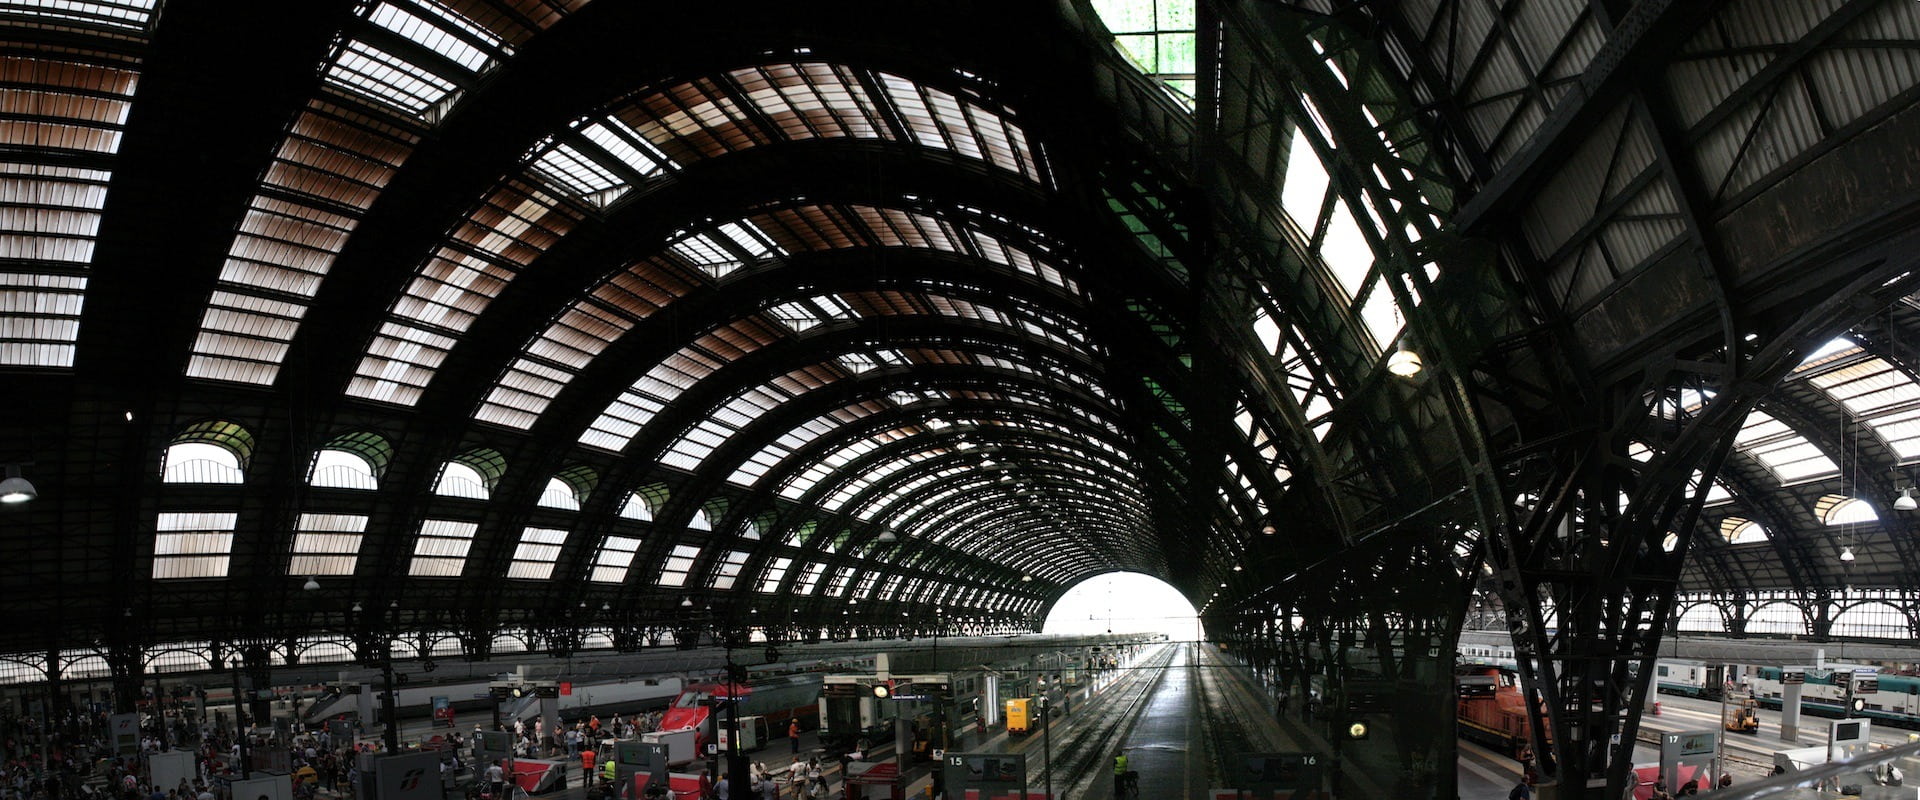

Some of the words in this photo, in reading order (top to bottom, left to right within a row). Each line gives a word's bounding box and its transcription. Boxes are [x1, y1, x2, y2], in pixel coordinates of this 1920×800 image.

[1669, 735, 1679, 744] 17
[652, 746, 661, 754] 14
[950, 756, 963, 766] 15
[1303, 756, 1317, 766] 16
